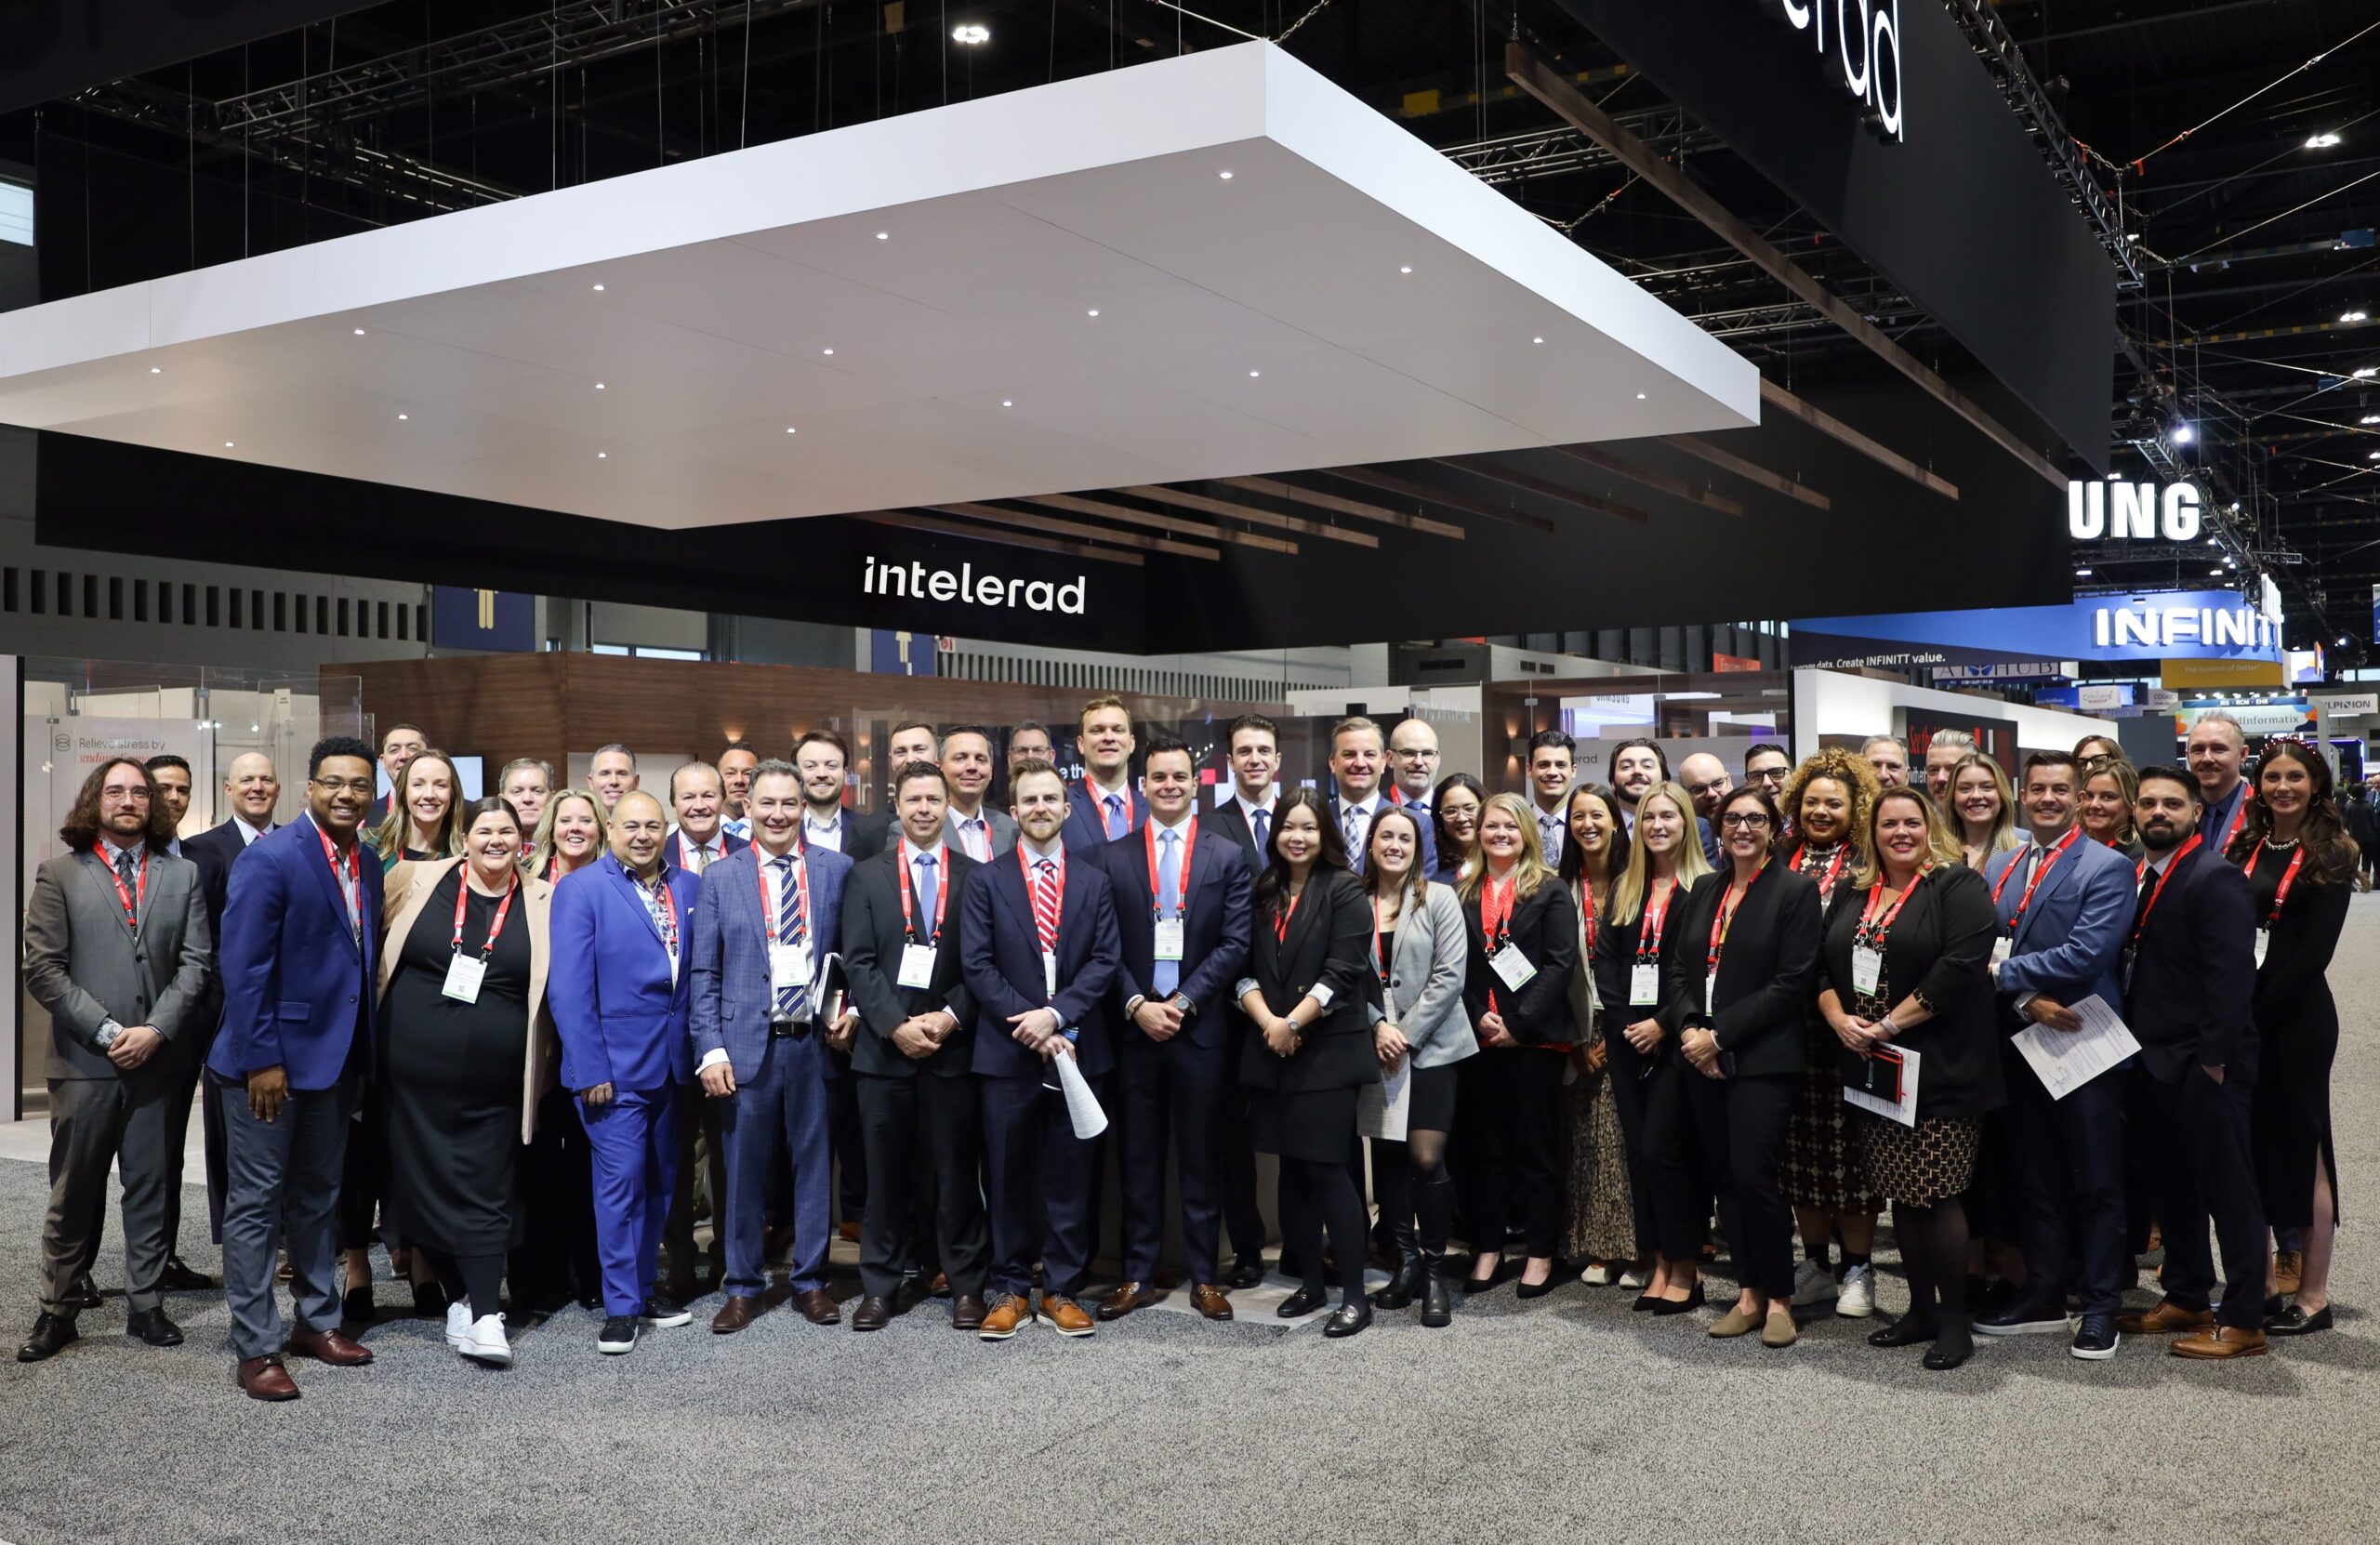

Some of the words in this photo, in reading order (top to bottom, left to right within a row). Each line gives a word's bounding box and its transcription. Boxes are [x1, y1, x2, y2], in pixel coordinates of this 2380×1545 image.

[2069, 481, 2200, 540] UNG
[864, 556, 1086, 614] intelerad
[1836, 658, 1864, 668] Create
[1866, 654, 1911, 667] INFINITT
[1912, 652, 1946, 663] value.
[2324, 700, 2371, 709] LPINION
[79, 737, 115, 749] Relieve
[116, 737, 150, 749] stress
[152, 736, 165, 751] by
